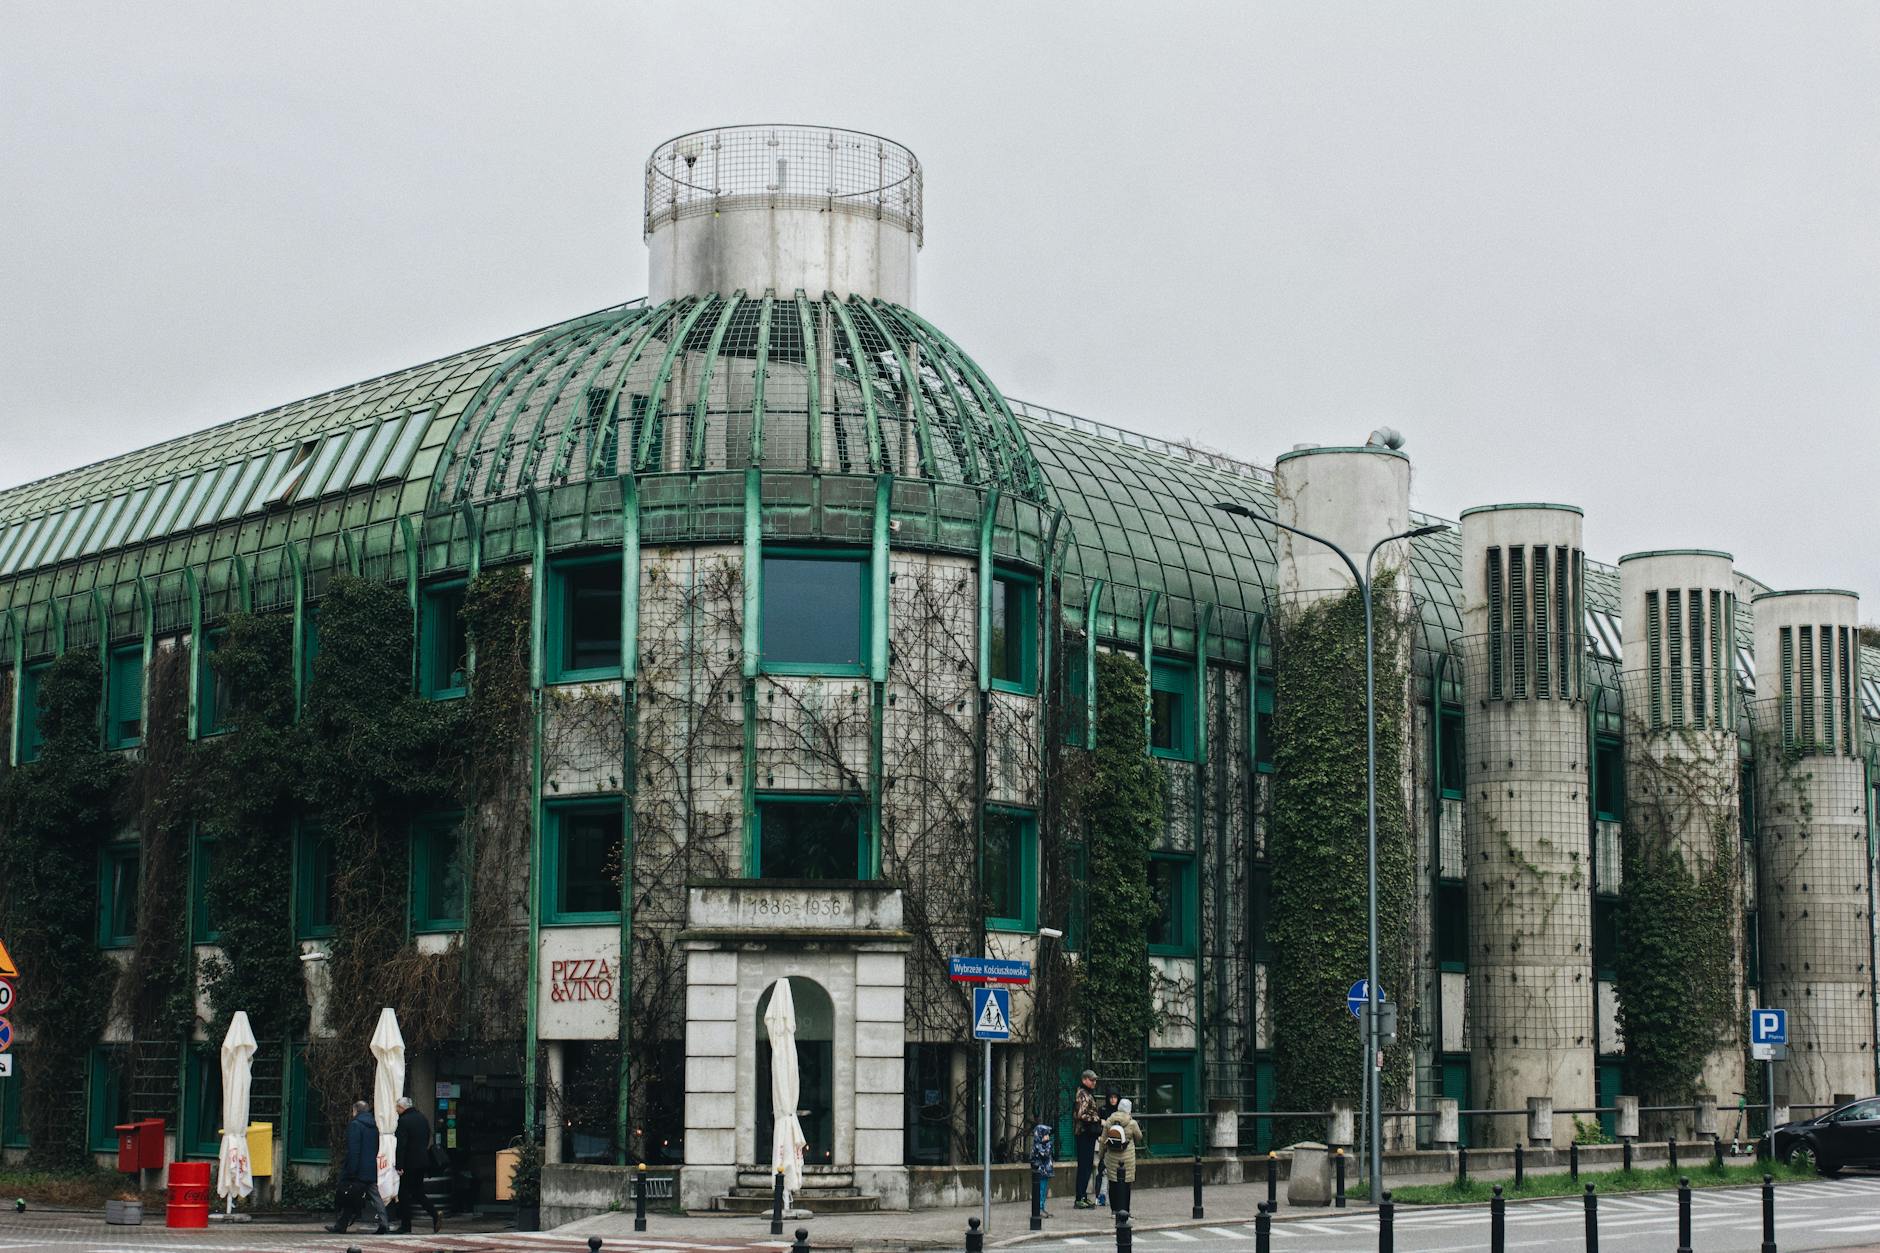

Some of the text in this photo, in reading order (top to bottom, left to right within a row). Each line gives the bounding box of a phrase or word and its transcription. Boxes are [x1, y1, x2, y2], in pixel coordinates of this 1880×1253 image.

[551, 958, 612, 981] PIZZA
[954, 964, 1027, 976] Wybrzeże Kościuszkowskie
[551, 979, 612, 1002] &VINO
[1760, 1013, 1778, 1039] P
